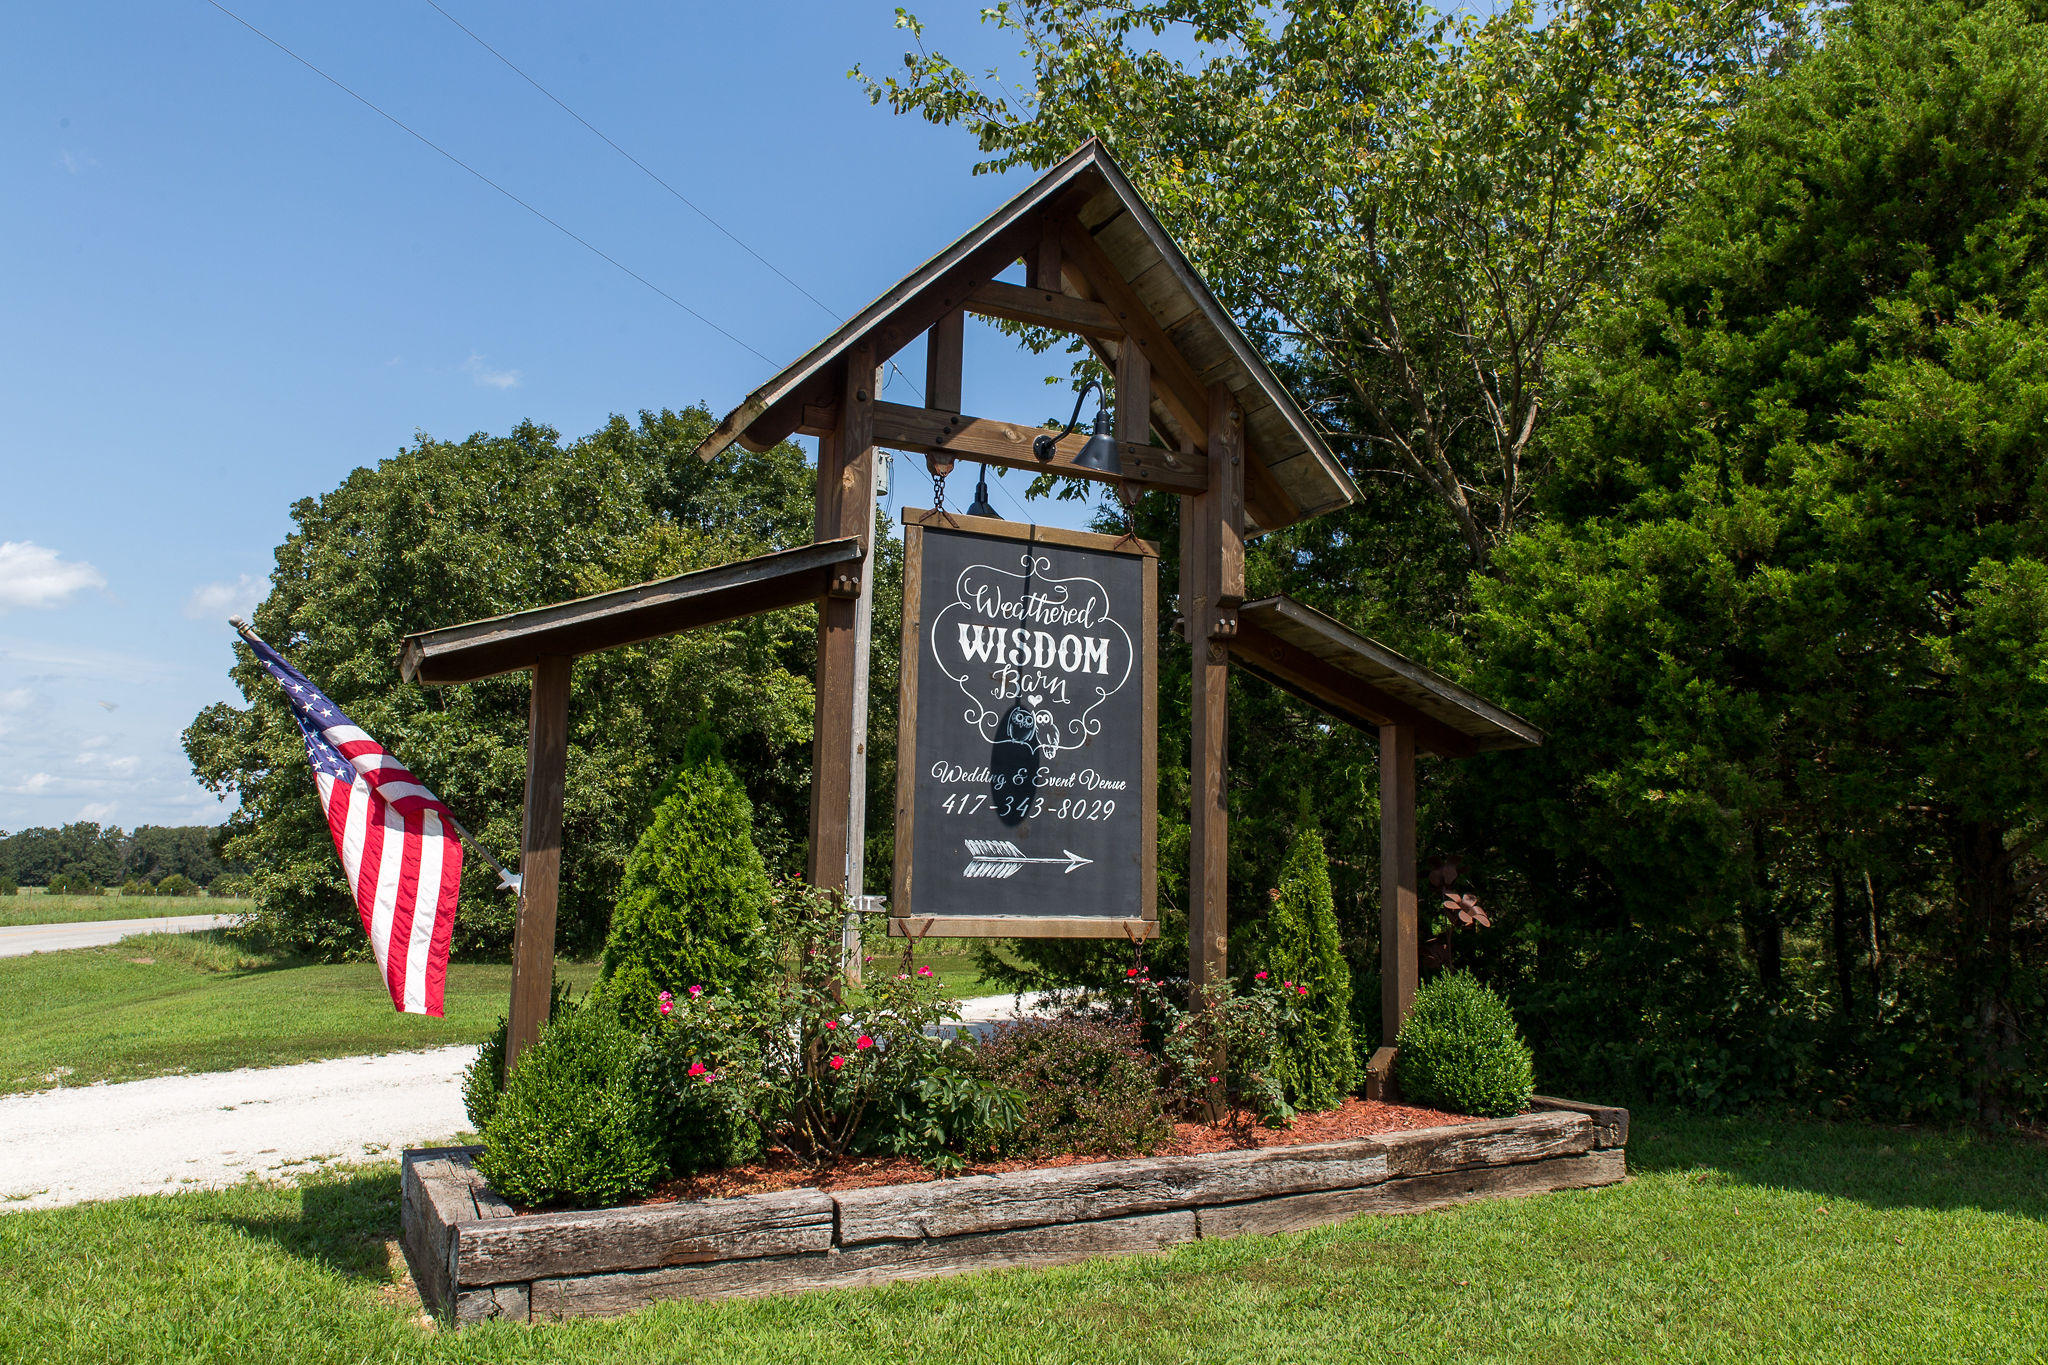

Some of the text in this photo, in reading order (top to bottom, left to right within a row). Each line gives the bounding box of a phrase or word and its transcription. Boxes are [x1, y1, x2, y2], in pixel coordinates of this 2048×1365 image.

[964, 577, 1097, 629] Weathered
[957, 623, 1110, 675] WISDOM
[991, 664, 1071, 705] Barn
[931, 761, 1127, 792] Wedding & Event Venue
[941, 793, 1116, 822] 417-343-8029
